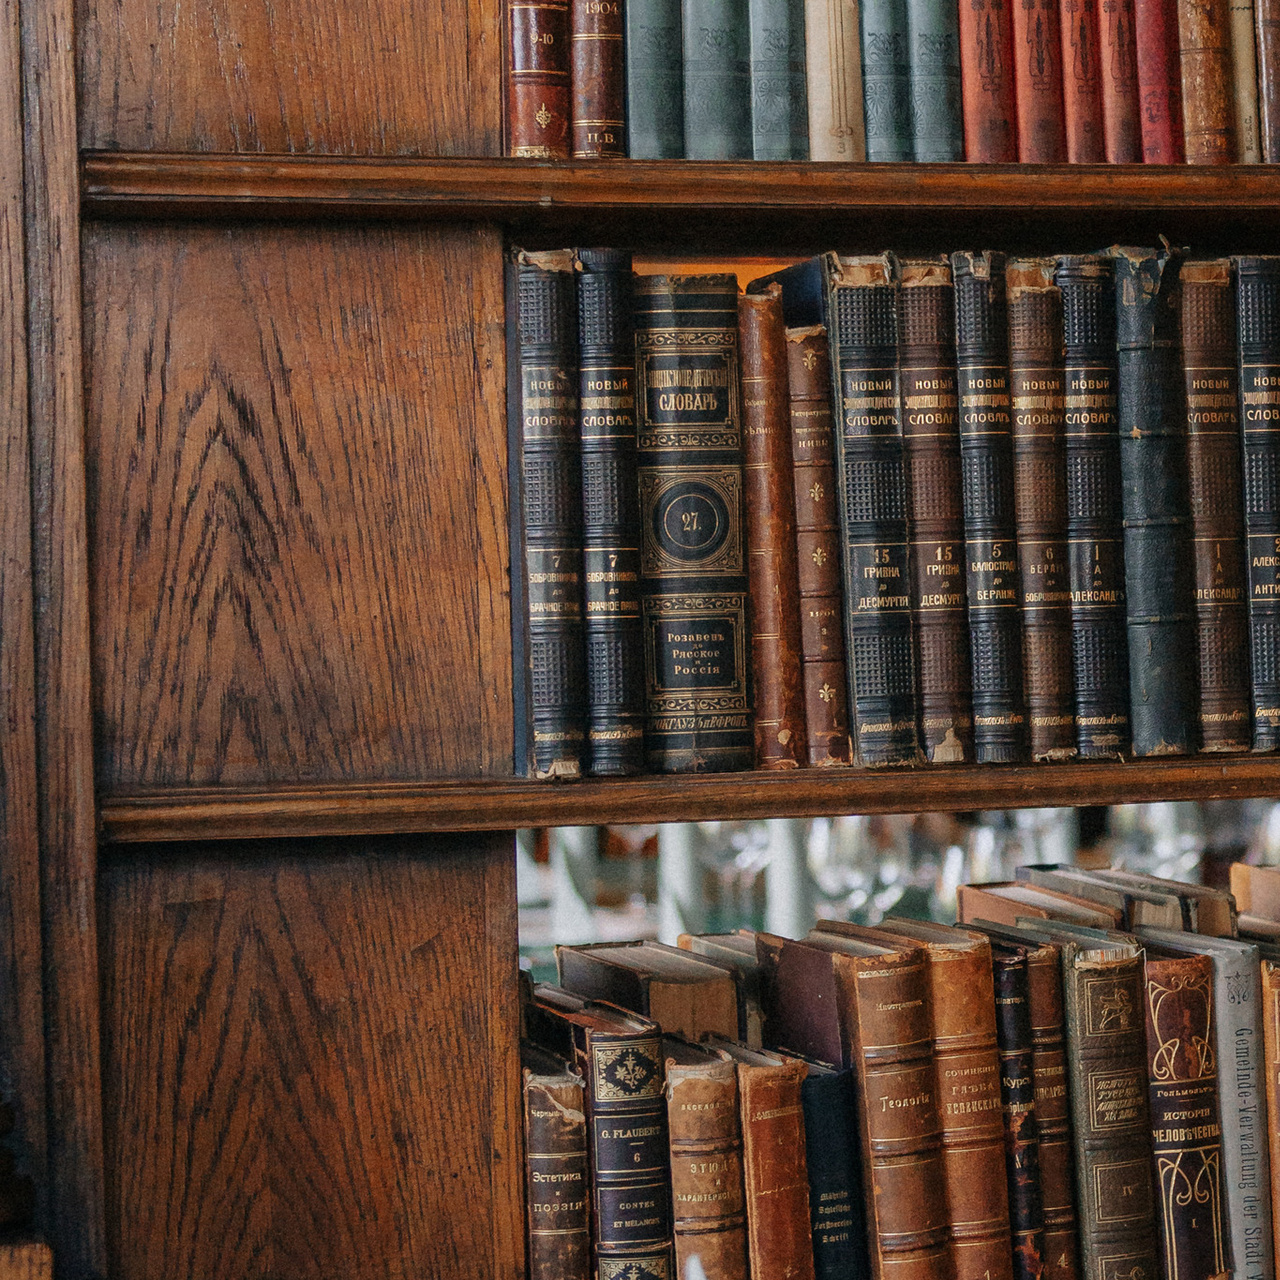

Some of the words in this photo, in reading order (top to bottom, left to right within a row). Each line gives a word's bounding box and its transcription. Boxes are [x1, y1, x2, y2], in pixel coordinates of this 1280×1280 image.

[585, 2, 619, 15] 1904
[588, 378, 629, 391] НОВЫЙ
[851, 379, 892, 391] НОВЫЙ
[1071, 377, 1110, 390] НОВЫЙ
[1193, 377, 1230, 389] НОВЫЙ
[659, 393, 718, 411] СЛОВАРЬ
[583, 415, 633, 427] СЛОВАРЬ
[846, 415, 900, 426] СЛОВАРЬ
[681, 511, 702, 531] 27.
[874, 549, 890, 564] 15
[935, 546, 953, 561] 15
[992, 543, 1002, 558] 5
[1046, 548, 1054, 560] 6
[552, 555, 560, 568] 7
[608, 554, 618, 569] 7
[864, 566, 900, 578] ГРИВНА
[1094, 565, 1102, 575] А
[587, 600, 619, 611] БРАЧНОЕ
[672, 649, 720, 659] Рясское
[674, 663, 721, 675] Россія
[880, 1092, 930, 1112] Теологія
[1234, 1027, 1259, 1190] Gemeinde-Verwaltung
[1163, 1108, 1210, 1121] ИСТОРІЯ
[601, 1129, 611, 1139] G.
[613, 1125, 661, 1138] FLAUBERT
[1152, 1123, 1221, 1143] ЧЕЛОВѢЧЕСТВА
[634, 1152, 641, 1163] 6
[532, 1171, 582, 1183] Эстетика
[619, 1200, 655, 1211] CONTES
[1247, 1190, 1262, 1221] der
[613, 1220, 623, 1228] ET
[1244, 1226, 1263, 1268] Stadt
